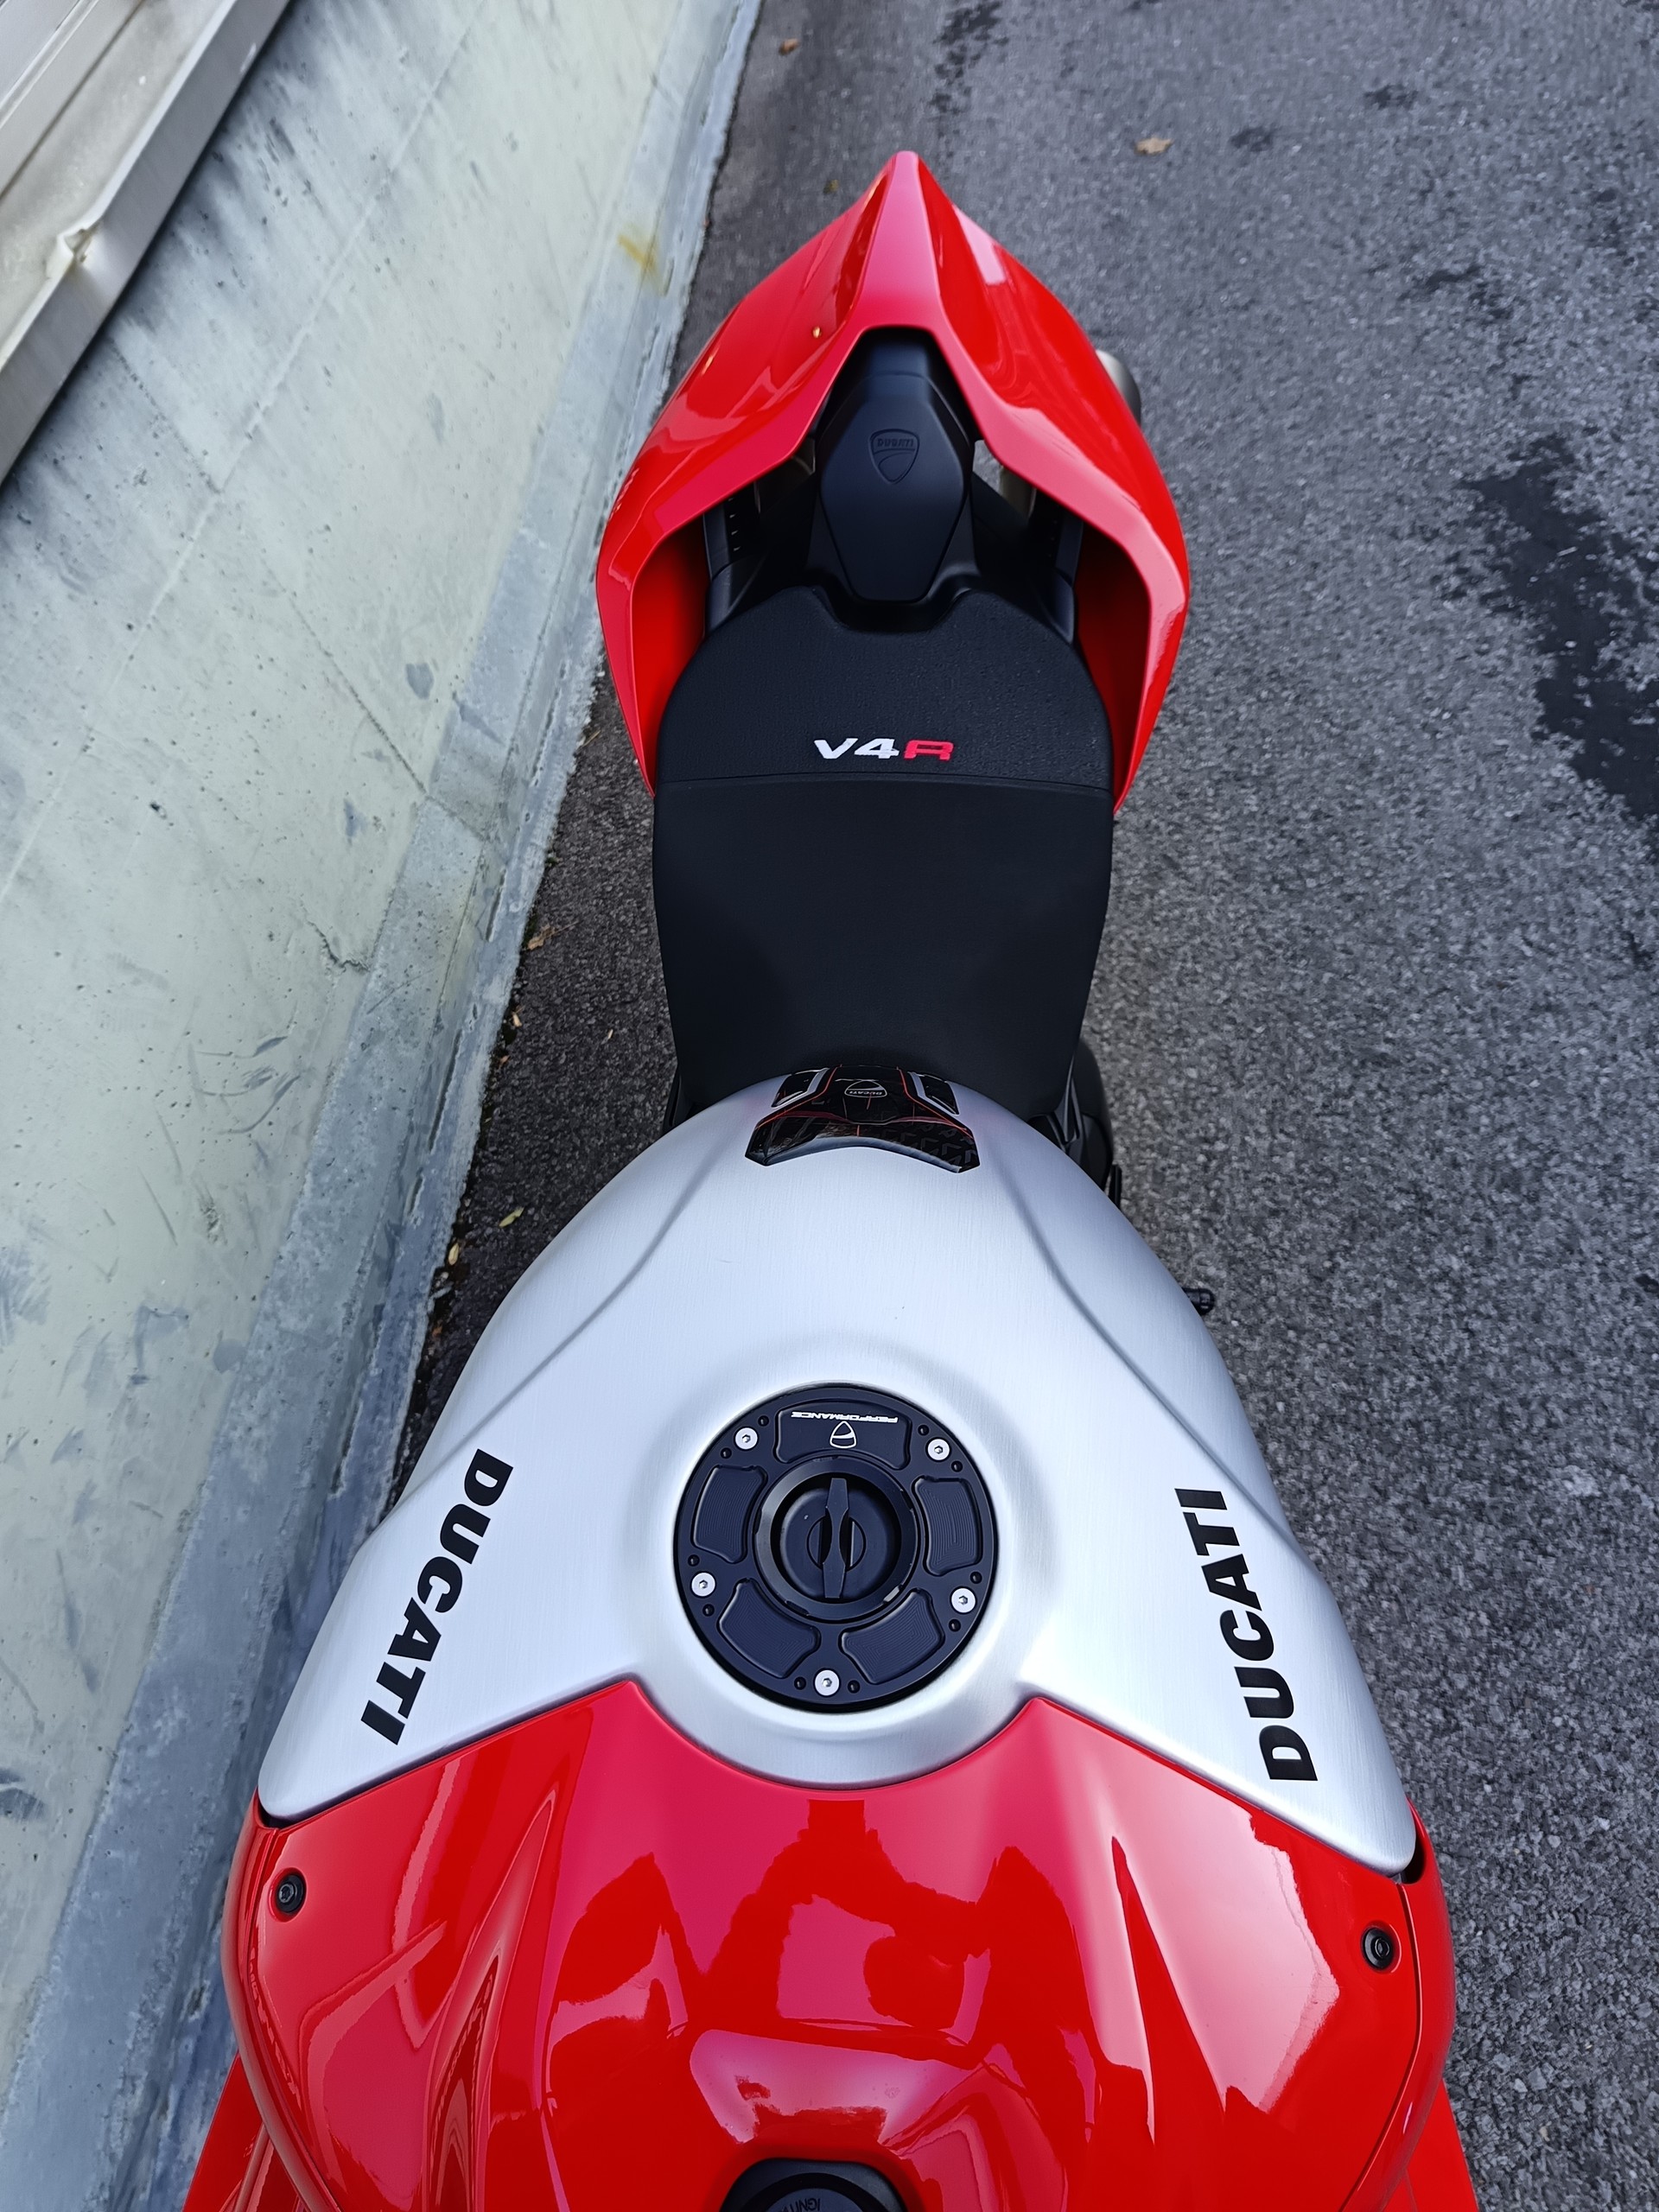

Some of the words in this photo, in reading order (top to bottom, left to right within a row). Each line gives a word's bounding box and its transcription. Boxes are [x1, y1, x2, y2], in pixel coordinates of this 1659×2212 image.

[877, 438, 914, 447] DUCATI
[791, 1411, 899, 1423] PERFORMANCE
[360, 1448, 514, 1745] DUCATI
[1174, 1488, 1318, 1782] DUCATI
